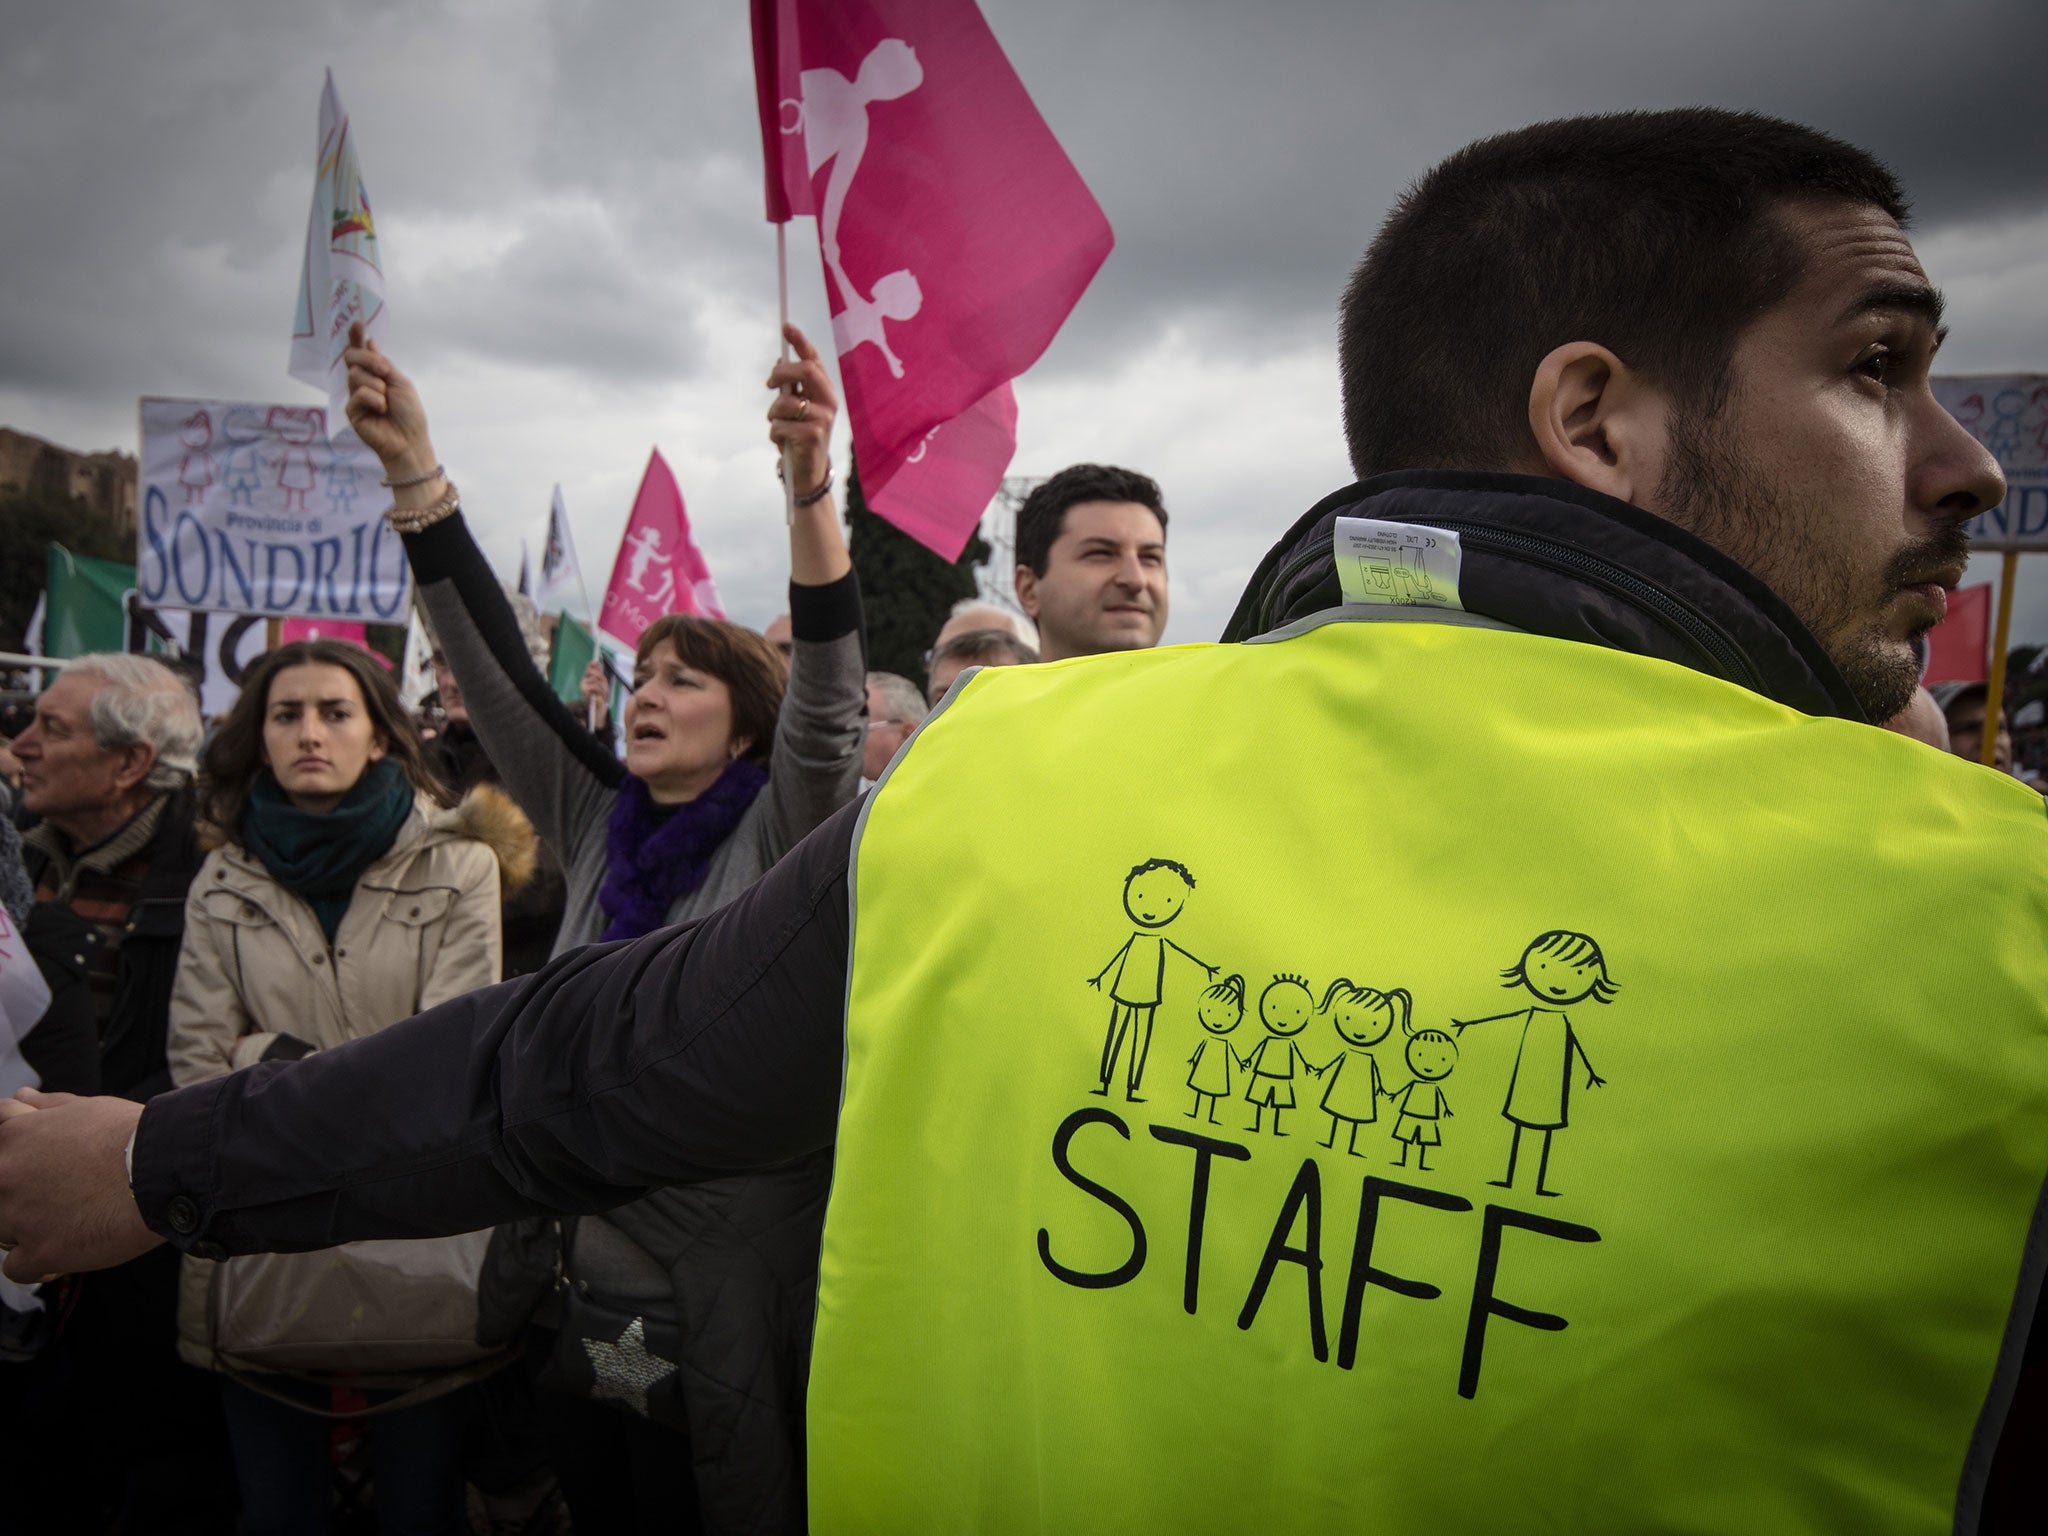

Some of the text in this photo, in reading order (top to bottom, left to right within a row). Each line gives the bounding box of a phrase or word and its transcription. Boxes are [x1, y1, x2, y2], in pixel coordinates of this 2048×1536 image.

[226, 511, 322, 534] Provincia di
[1377, 531, 1398, 539] CLOTHING
[1405, 535, 1419, 544] L/XL
[144, 484, 407, 618] SONDRIO
[1037, 1108, 1601, 1399] STAFF
